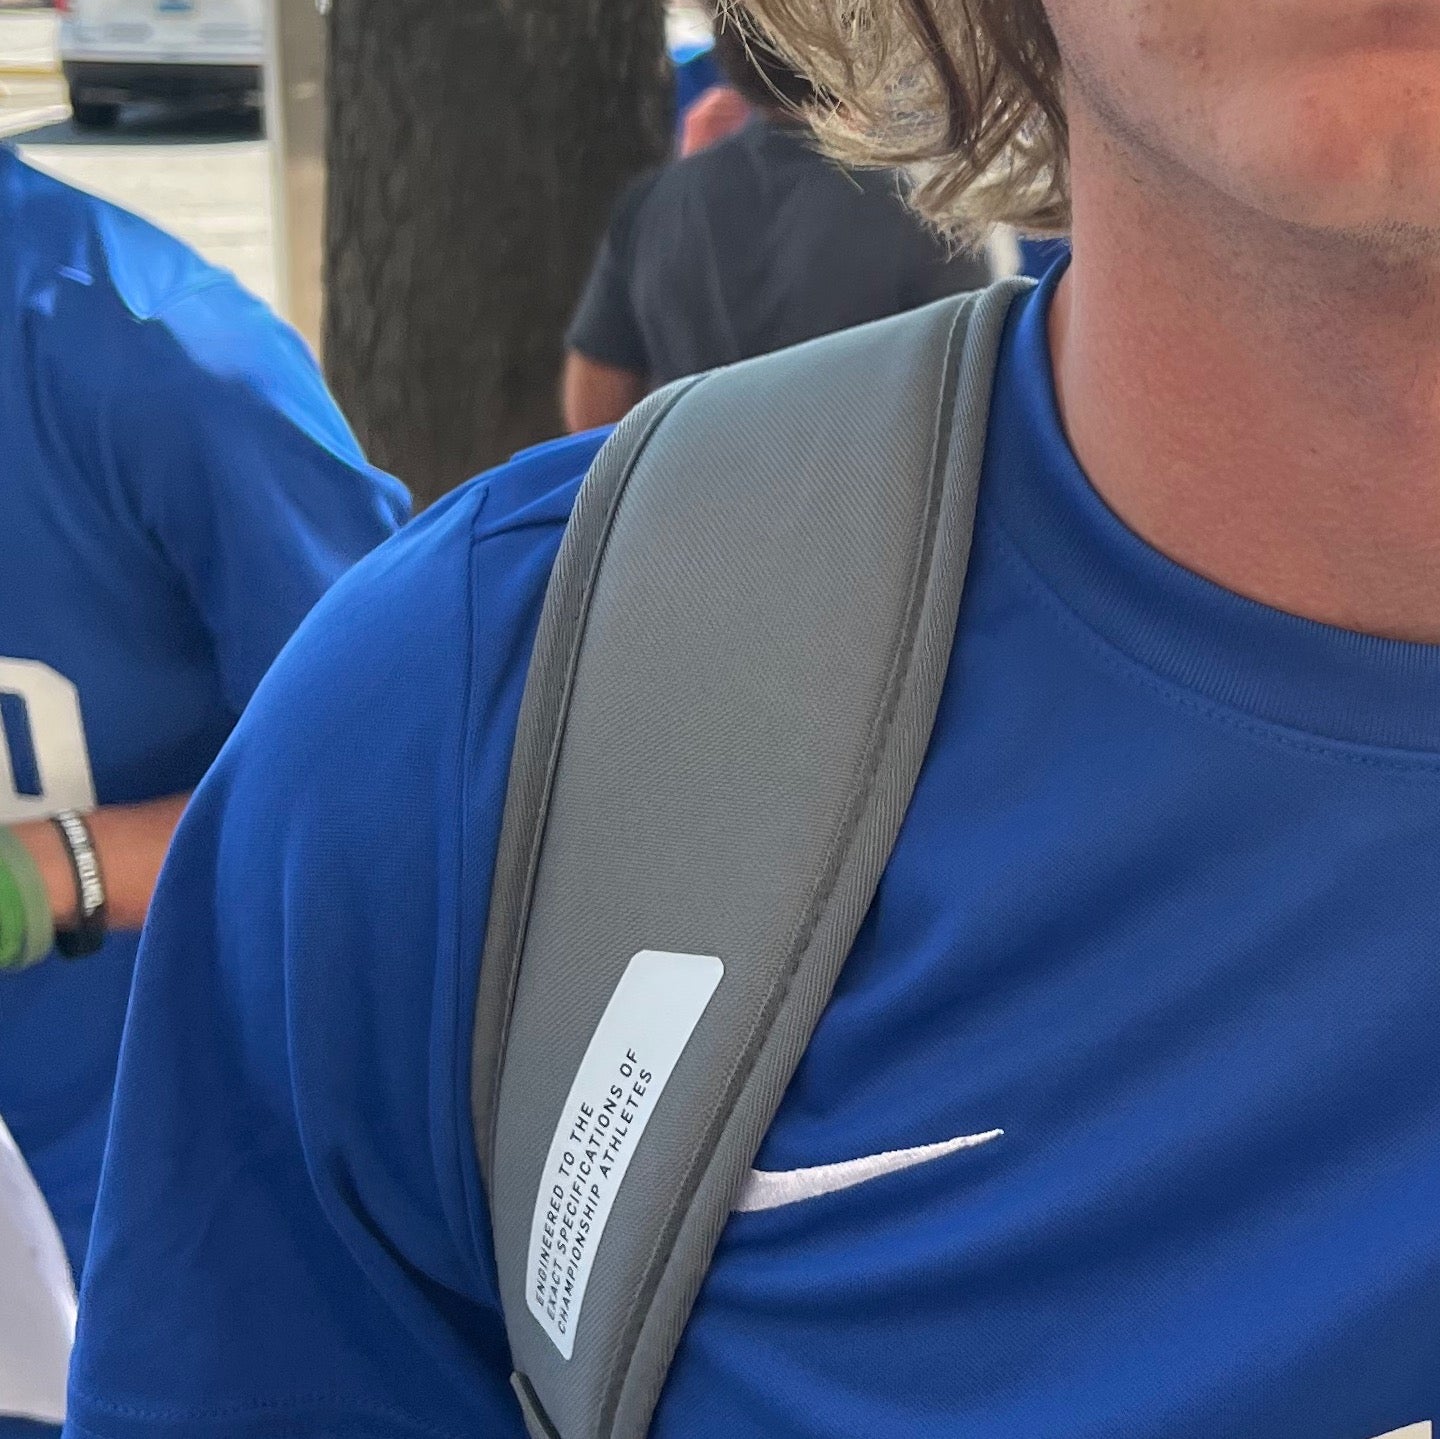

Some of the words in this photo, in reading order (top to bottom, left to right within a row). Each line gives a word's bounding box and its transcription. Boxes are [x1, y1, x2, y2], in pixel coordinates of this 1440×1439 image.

[535, 1184, 564, 1307] ENGINEERED
[558, 1151, 575, 1176] TO
[569, 1101, 594, 1143] THE
[546, 1258, 563, 1321] EXACT
[556, 1084, 623, 1255] SPECIFICATIONS
[619, 1047, 638, 1078] OF
[557, 1183, 601, 1335] CHAMPIONSHIP
[599, 1068, 652, 1179] ATHLETES
